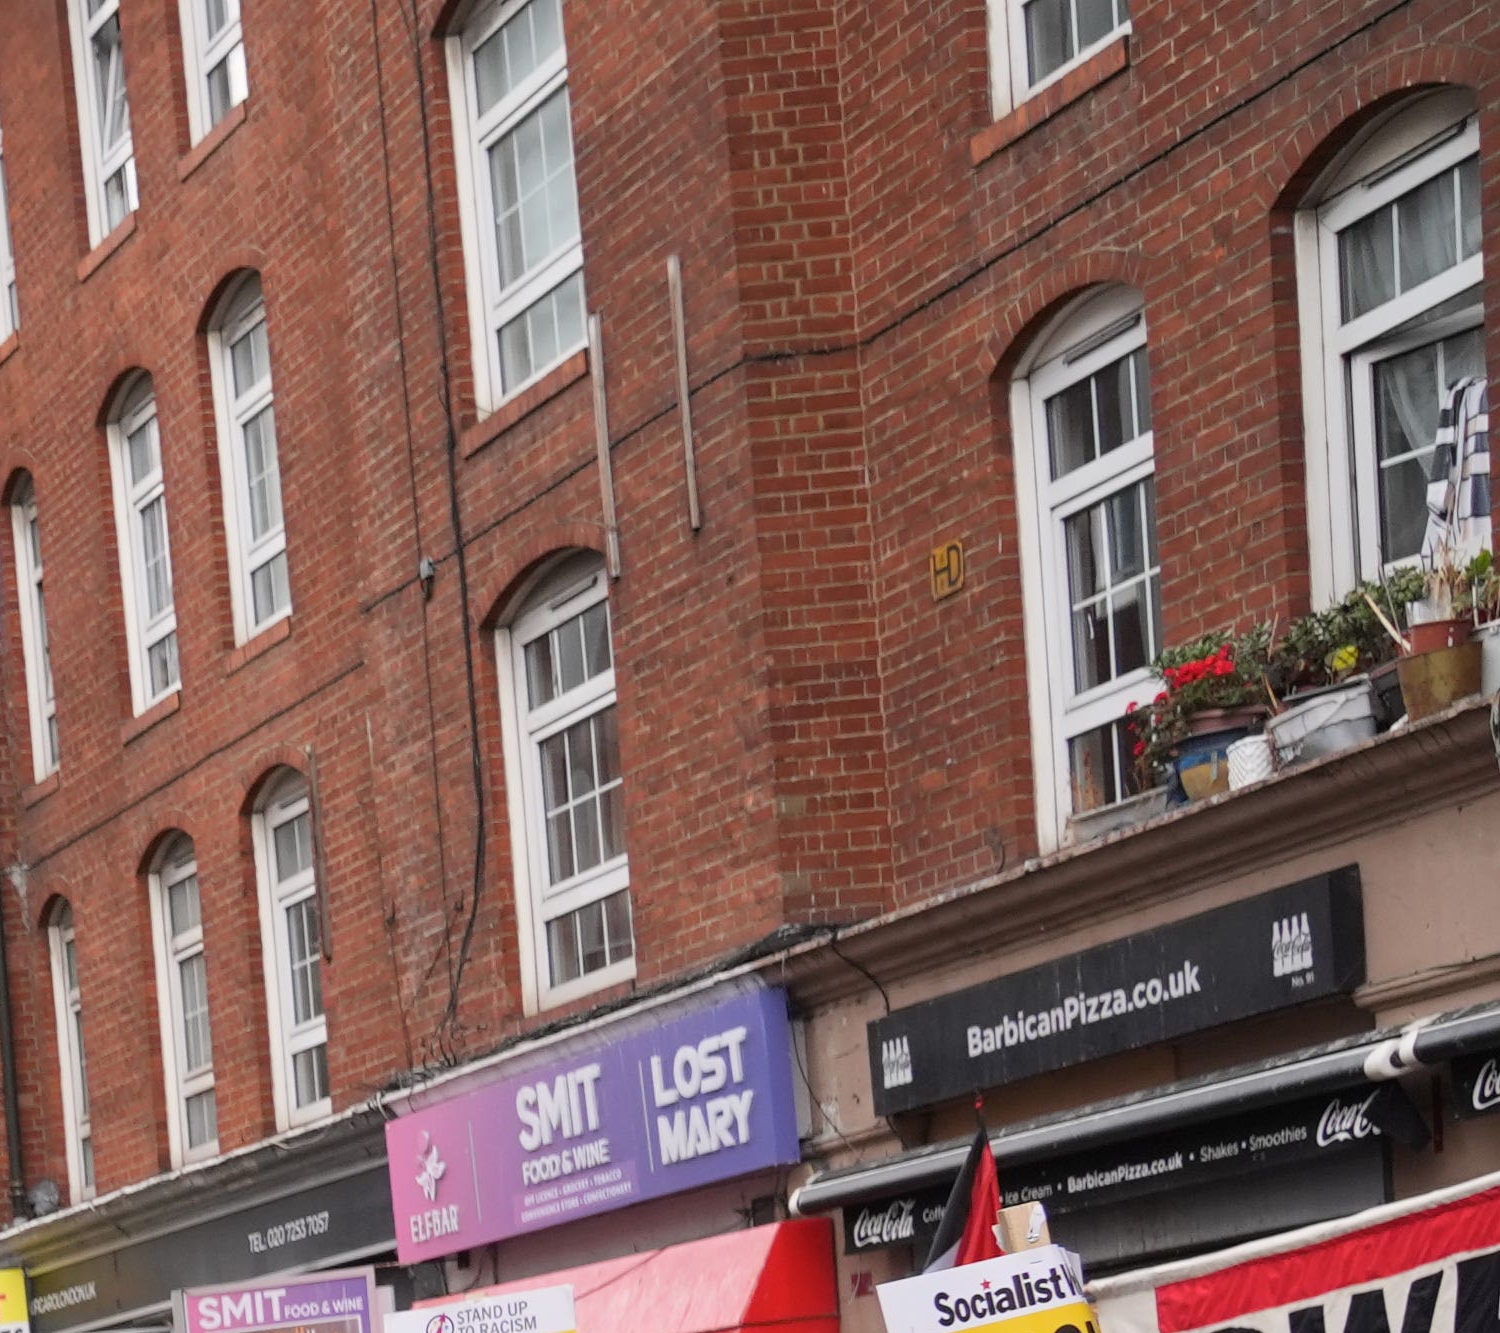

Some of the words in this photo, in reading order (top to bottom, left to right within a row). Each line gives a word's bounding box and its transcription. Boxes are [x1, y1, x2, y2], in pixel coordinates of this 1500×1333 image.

[967, 961, 1201, 1058] BarbicanPizza.co.uk
[651, 1026, 747, 1107] LOST
[516, 1063, 600, 1152] SMIT
[657, 1090, 754, 1165] MARY
[1067, 1152, 1183, 1194] BarbicanPizza.co.uk
[1200, 1141, 1239, 1162] Shakes
[1249, 1126, 1307, 1150] Smoothies
[411, 1207, 459, 1244] ELFBAR
[198, 1288, 286, 1329] SMIT
[284, 1303, 319, 1319] FOOD
[321, 1303, 330, 1315] &
[332, 1296, 364, 1314] WINE
[457, 1305, 503, 1325] STAND
[508, 1301, 529, 1316] UP
[935, 1269, 1065, 1326] Socialist
